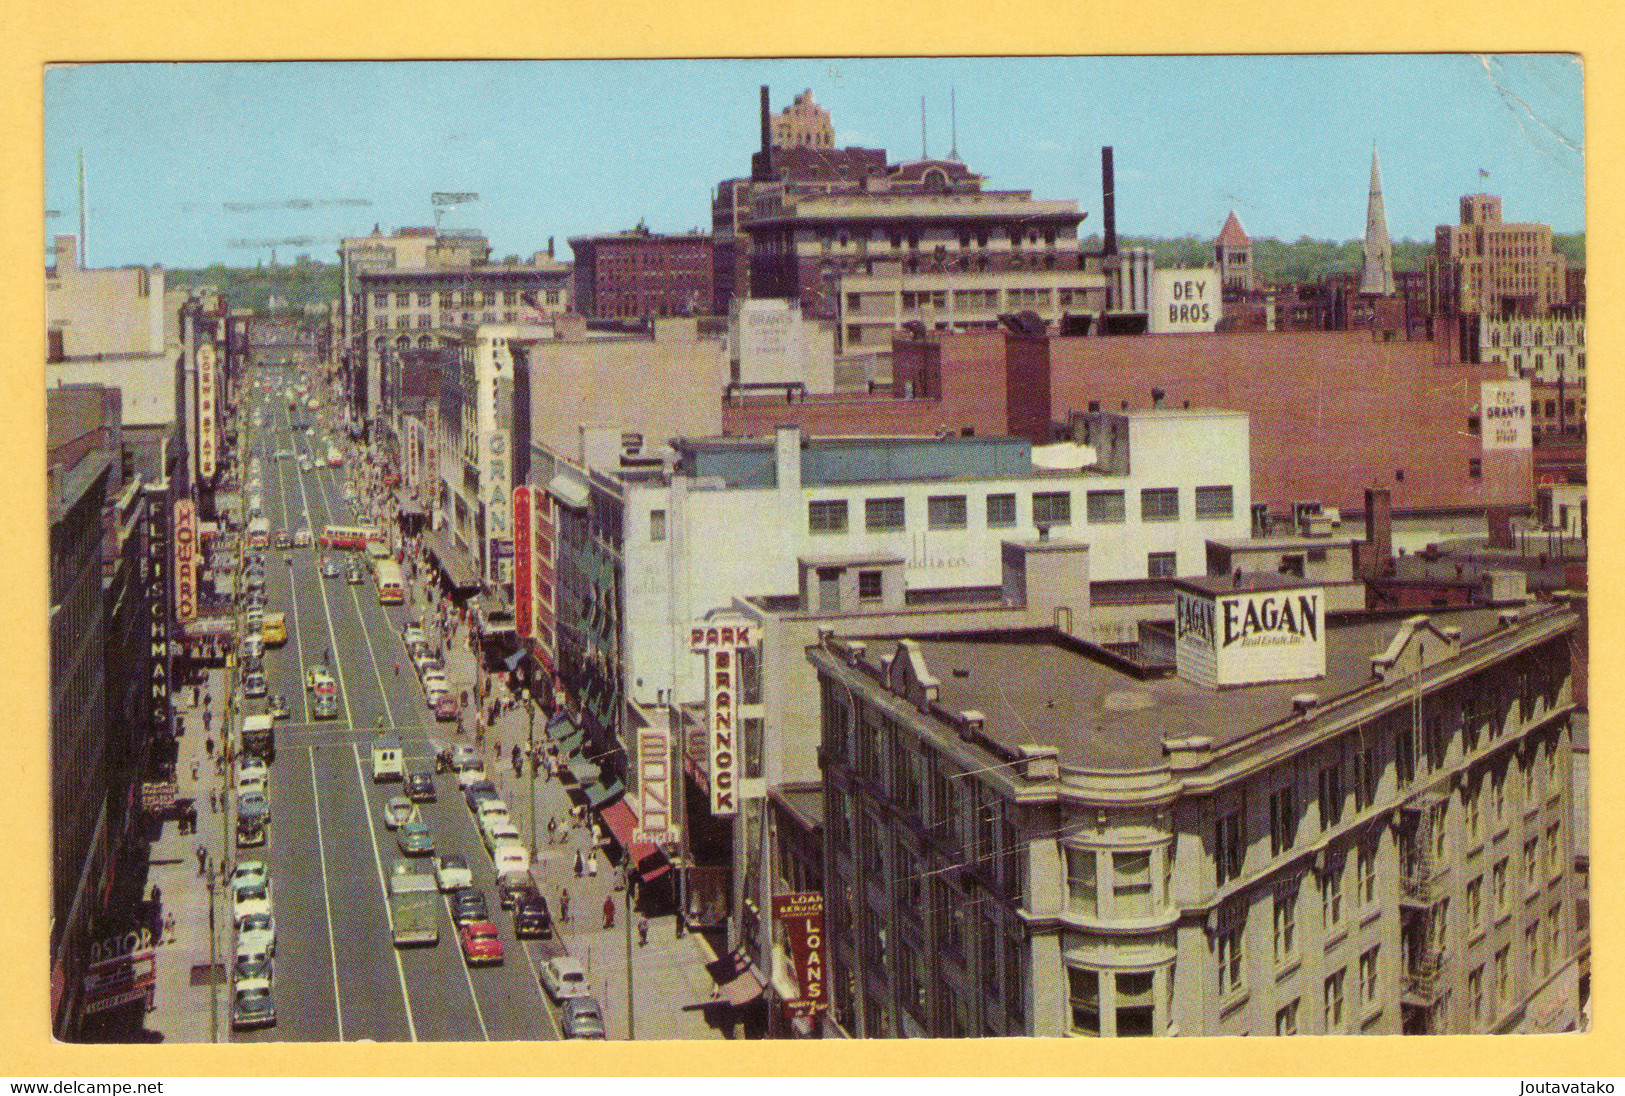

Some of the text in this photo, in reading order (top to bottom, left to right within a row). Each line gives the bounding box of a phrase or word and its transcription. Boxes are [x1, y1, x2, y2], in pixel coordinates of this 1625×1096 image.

[1173, 281, 1206, 300] DEY
[1169, 304, 1209, 323] BROS
[1487, 405, 1525, 418] GRANTS
[202, 417, 211, 473] STATE
[178, 508, 193, 617] HOWARD
[691, 627, 749, 647] PARK
[1177, 595, 1216, 652] EAGAN
[1222, 596, 1317, 648] EAGAN
[715, 651, 733, 811] BRANNOCK
[641, 730, 668, 832] BOND
[780, 903, 824, 914] SERVICE
[790, 896, 824, 905] LOAN
[90, 927, 152, 963] ASTOR
[806, 918, 821, 998] LOANS
